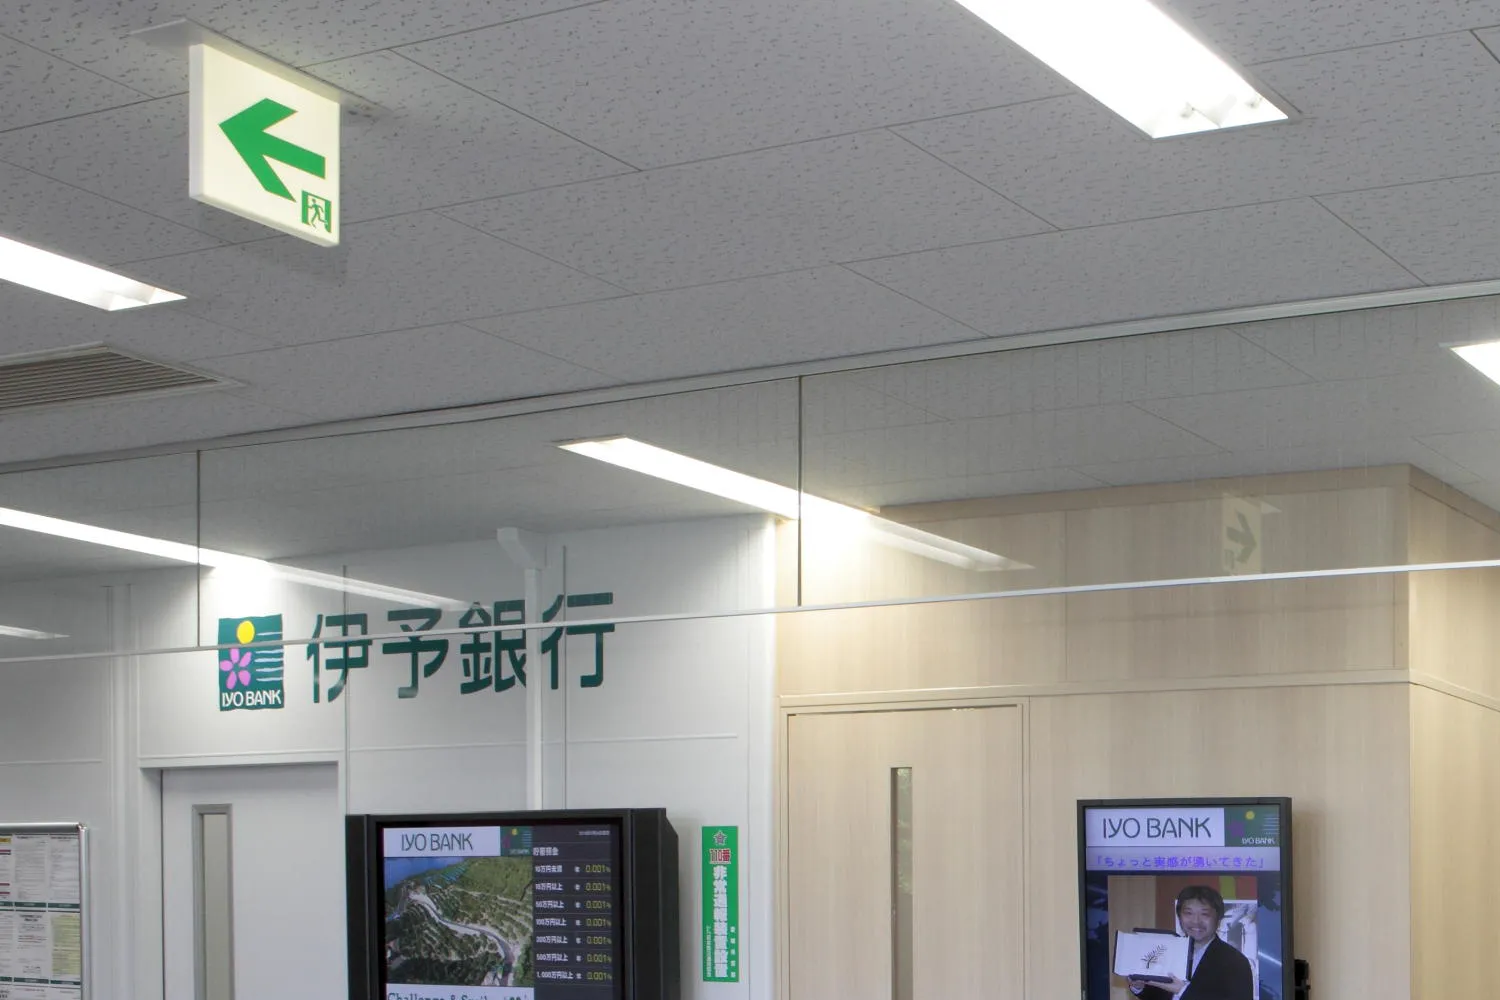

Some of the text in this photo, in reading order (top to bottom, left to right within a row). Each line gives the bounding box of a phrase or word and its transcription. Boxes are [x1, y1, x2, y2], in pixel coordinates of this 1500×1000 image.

[307, 591, 615, 704] 伊予銀行
[222, 690, 282, 707] IYO BANK
[1103, 817, 1211, 838] IYO BANK
[401, 832, 473, 851] IYO BANK
